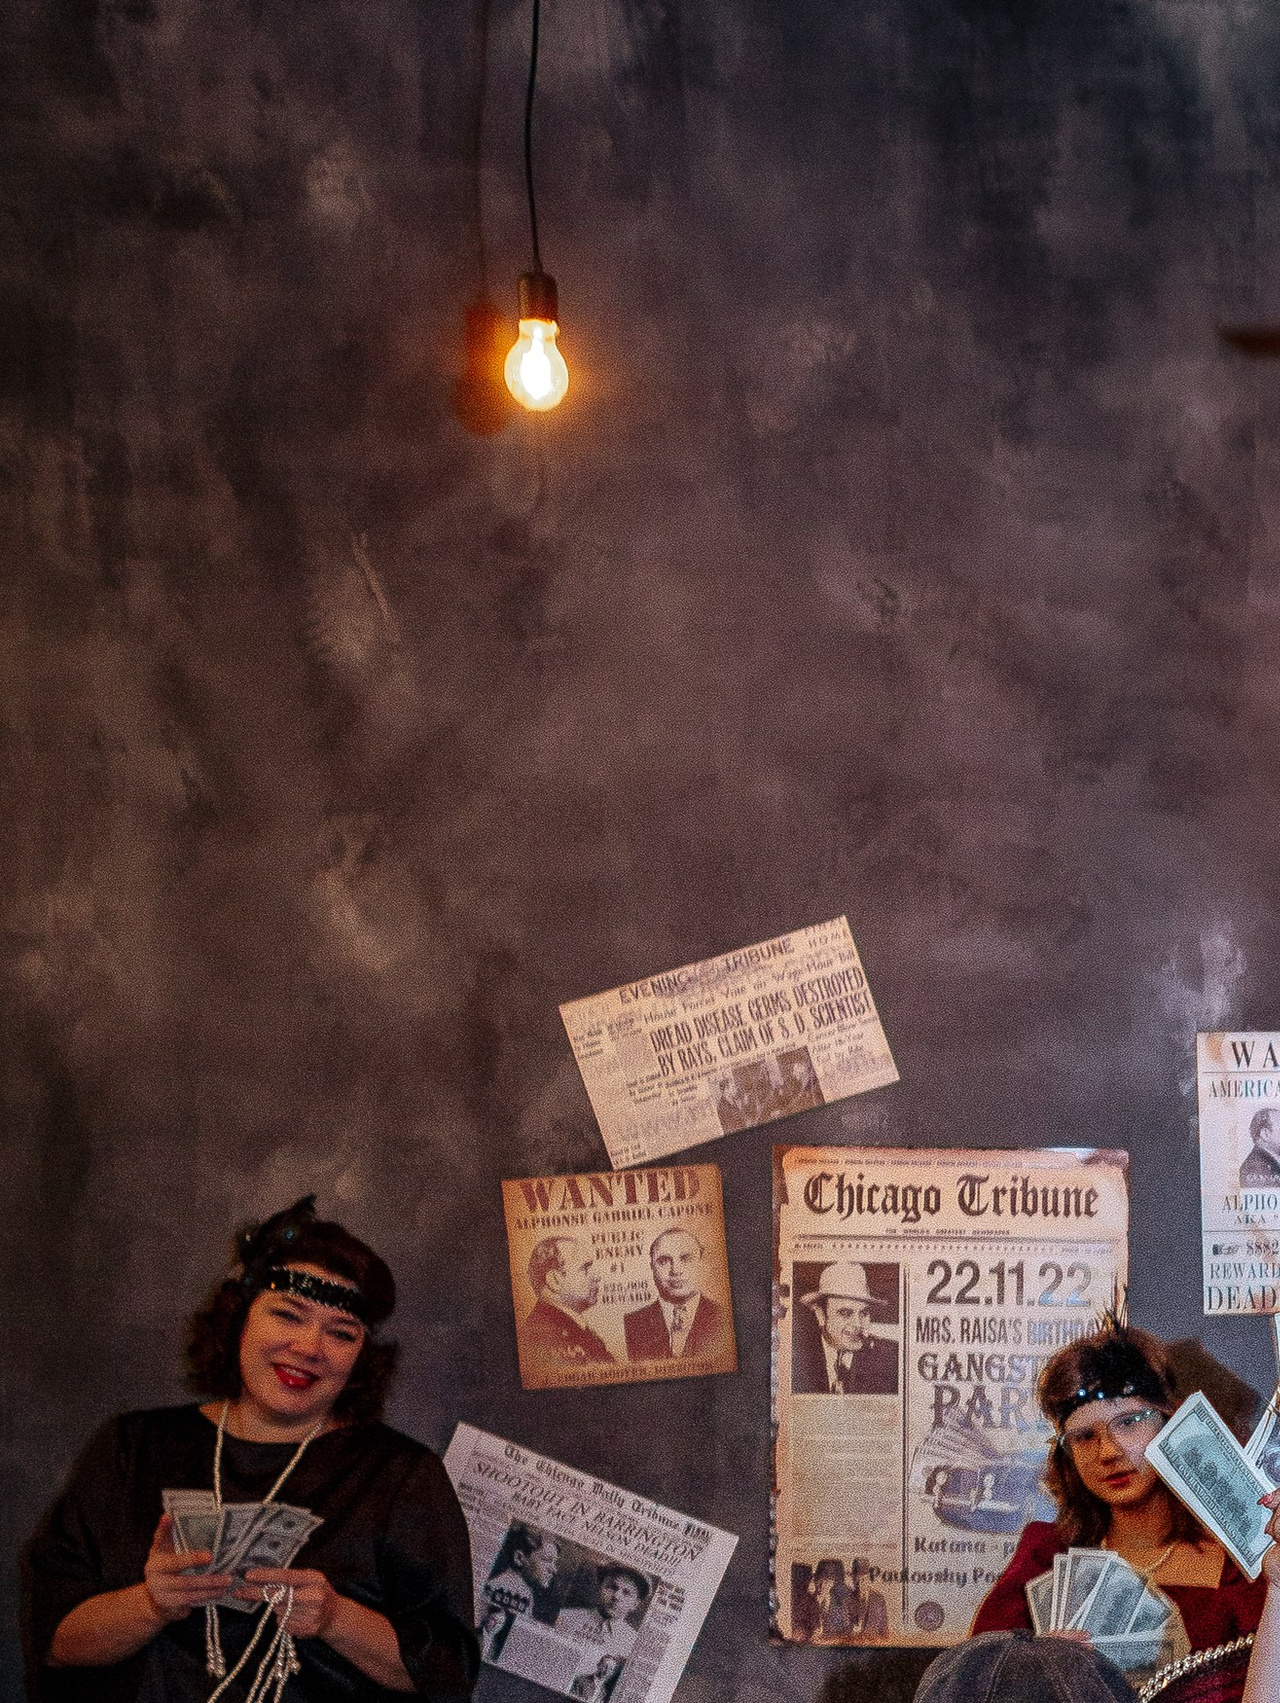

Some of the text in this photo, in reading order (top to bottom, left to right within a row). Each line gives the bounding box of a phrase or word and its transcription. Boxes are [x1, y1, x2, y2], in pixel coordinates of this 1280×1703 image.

[618, 969, 691, 1006] EVENING
[723, 937, 794, 973] TRIBUNE
[649, 1020, 693, 1053] DREAD
[693, 1003, 746, 1039] DISEASE
[746, 988, 792, 1022] GERMS
[791, 965, 865, 1008] DESTROYED
[657, 1053, 677, 1077] BY
[716, 1027, 757, 1059] CLAIM
[757, 1021, 777, 1046] OF
[809, 990, 872, 1029] SCIENTIST
[518, 1168, 700, 1213] WANTED
[803, 1172, 1099, 1223] Chicago Tribune
[515, 1203, 712, 1229] ALPHONSE GABRIEL CAPONE
[596, 1246, 643, 1259] ENEMY
[927, 1259, 1092, 1308] 22.11.22
[1207, 1284, 1277, 1311] DEAD
[916, 1317, 1096, 1345] MRS. RAISA'S BIRTHDA
[917, 1352, 1044, 1384] GANGST
[930, 1384, 1036, 1432] PAR
[474, 1458, 567, 1509] SHOOTOUT
[569, 1499, 590, 1517] IN
[594, 1508, 699, 1564] BARRINGTON
